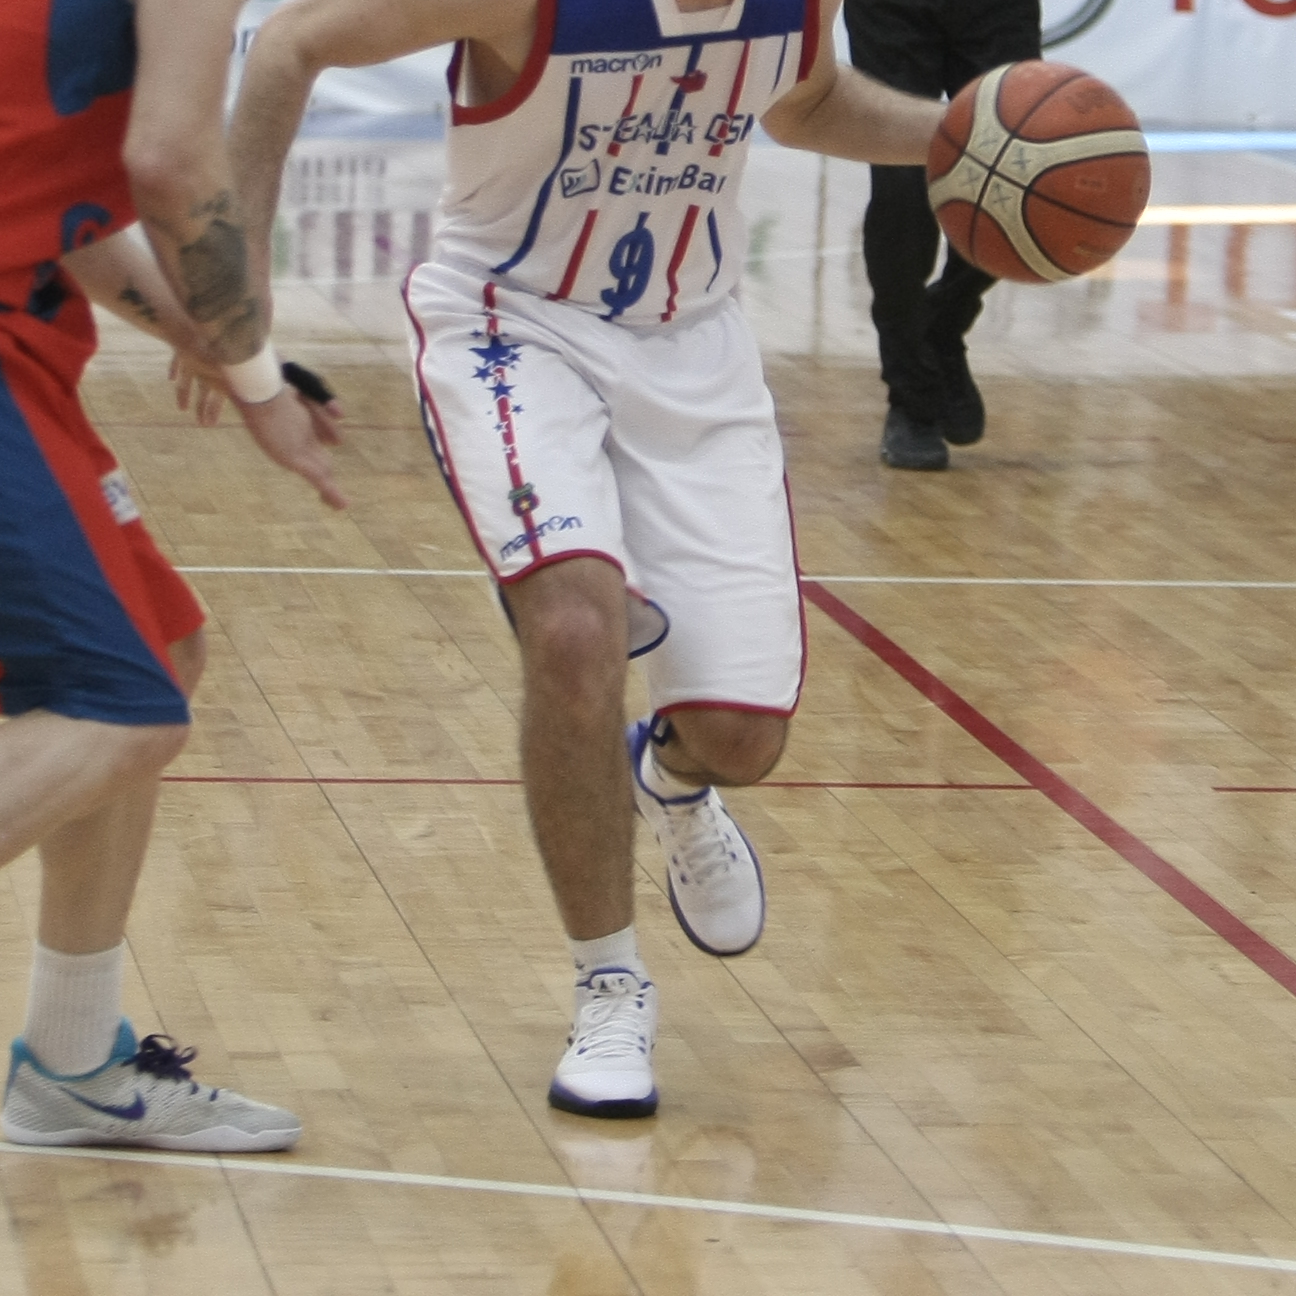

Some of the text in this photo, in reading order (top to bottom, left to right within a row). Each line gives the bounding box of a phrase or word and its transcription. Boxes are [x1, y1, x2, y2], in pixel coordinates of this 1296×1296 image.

[571, 54, 663, 74] macron
[579, 109, 696, 152] SEAUA
[600, 226, 655, 312] 9
